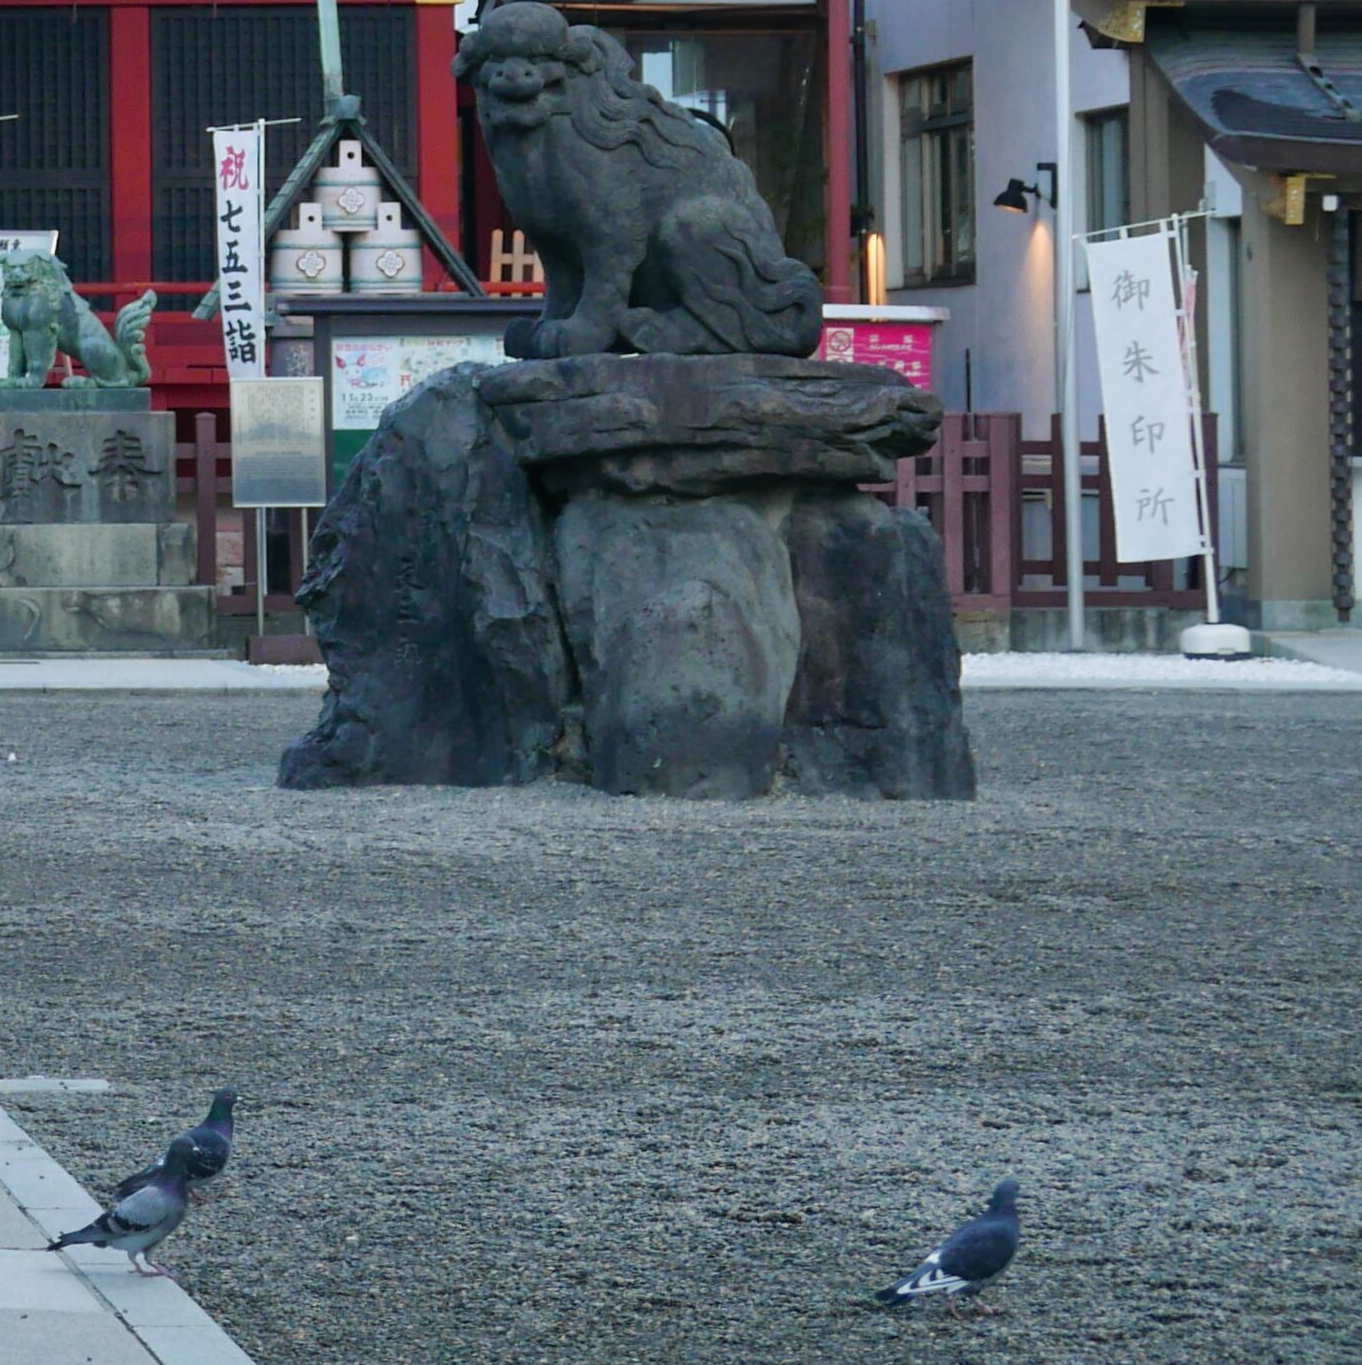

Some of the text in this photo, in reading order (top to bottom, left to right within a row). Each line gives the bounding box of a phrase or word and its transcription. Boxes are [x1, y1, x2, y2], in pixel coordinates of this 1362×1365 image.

[220, 145, 256, 363] 祝七五三詣
[1111, 269, 1175, 525] 御朱印所
